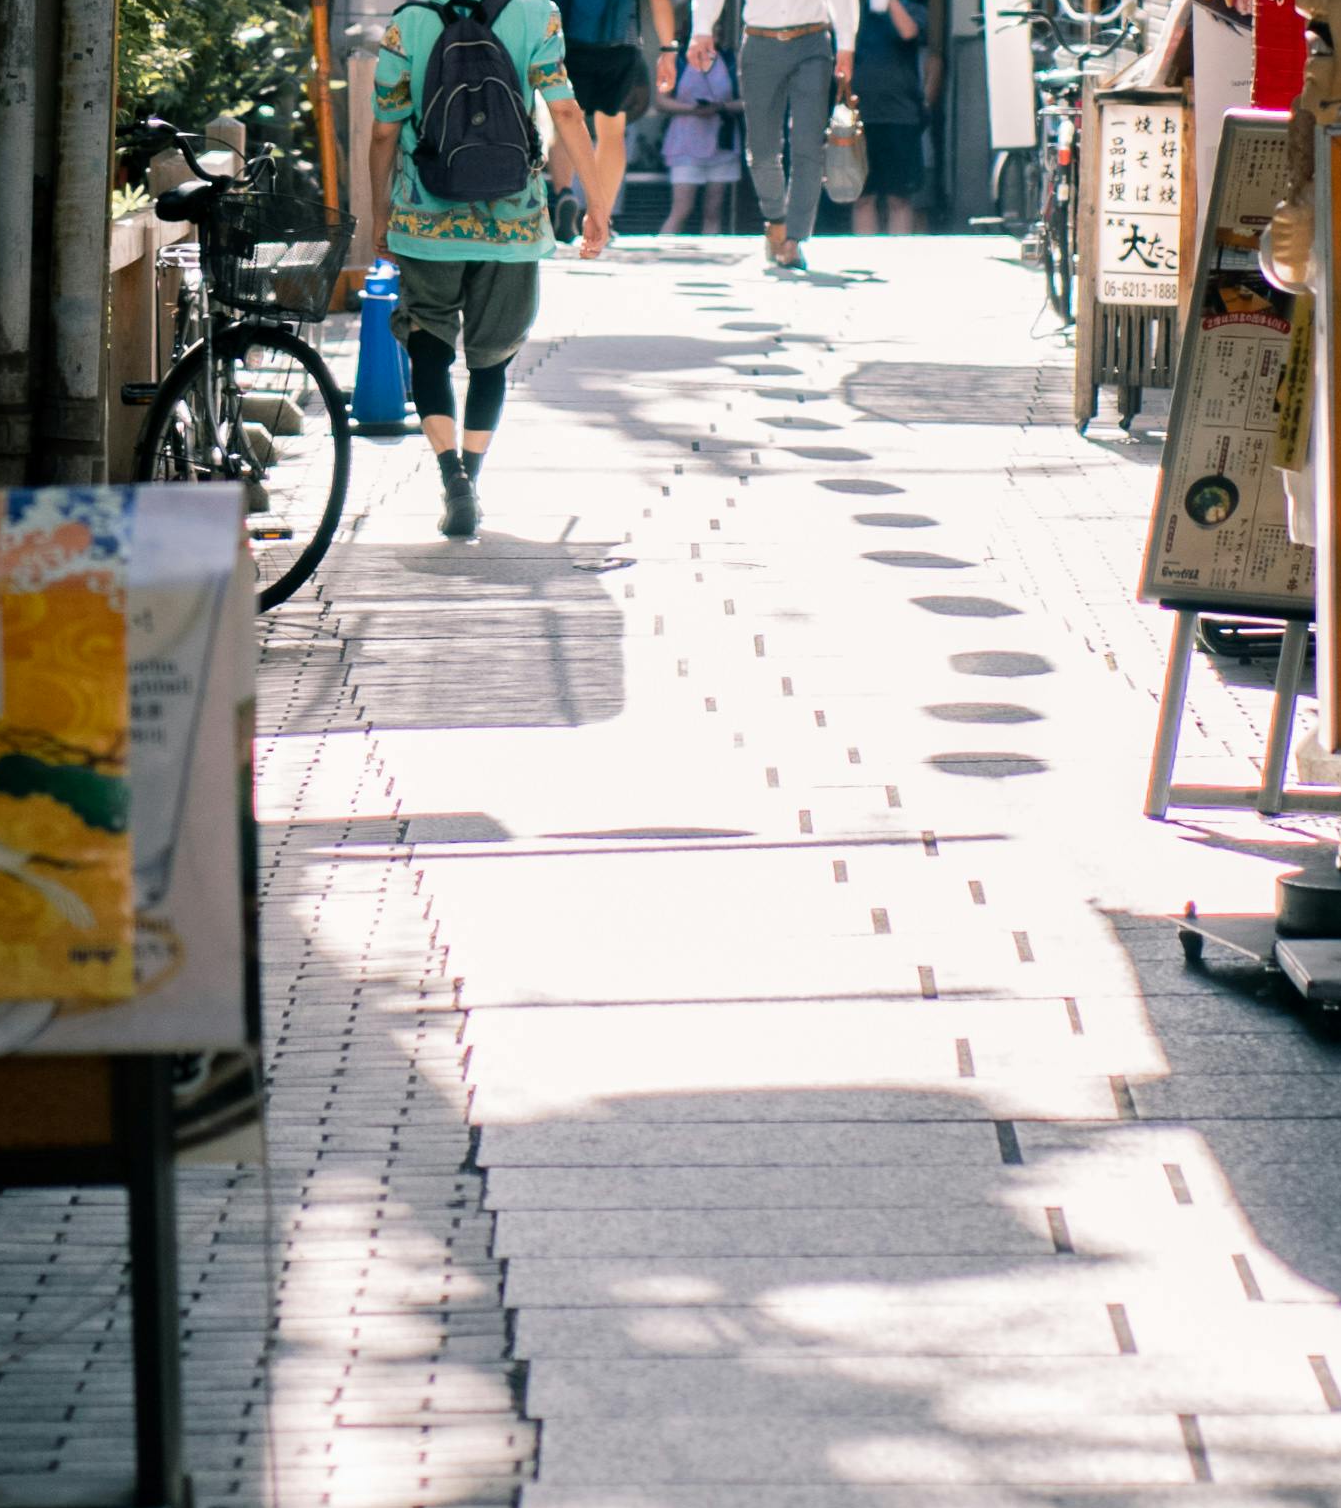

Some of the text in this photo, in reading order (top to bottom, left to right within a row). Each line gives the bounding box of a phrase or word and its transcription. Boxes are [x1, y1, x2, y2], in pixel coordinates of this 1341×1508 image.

[1109, 120, 1127, 202] 一品料理
[1159, 116, 1177, 205] お好み焼
[1118, 223, 1178, 270] 大たこ
[1104, 280, 1178, 300] 06-6213-1888
